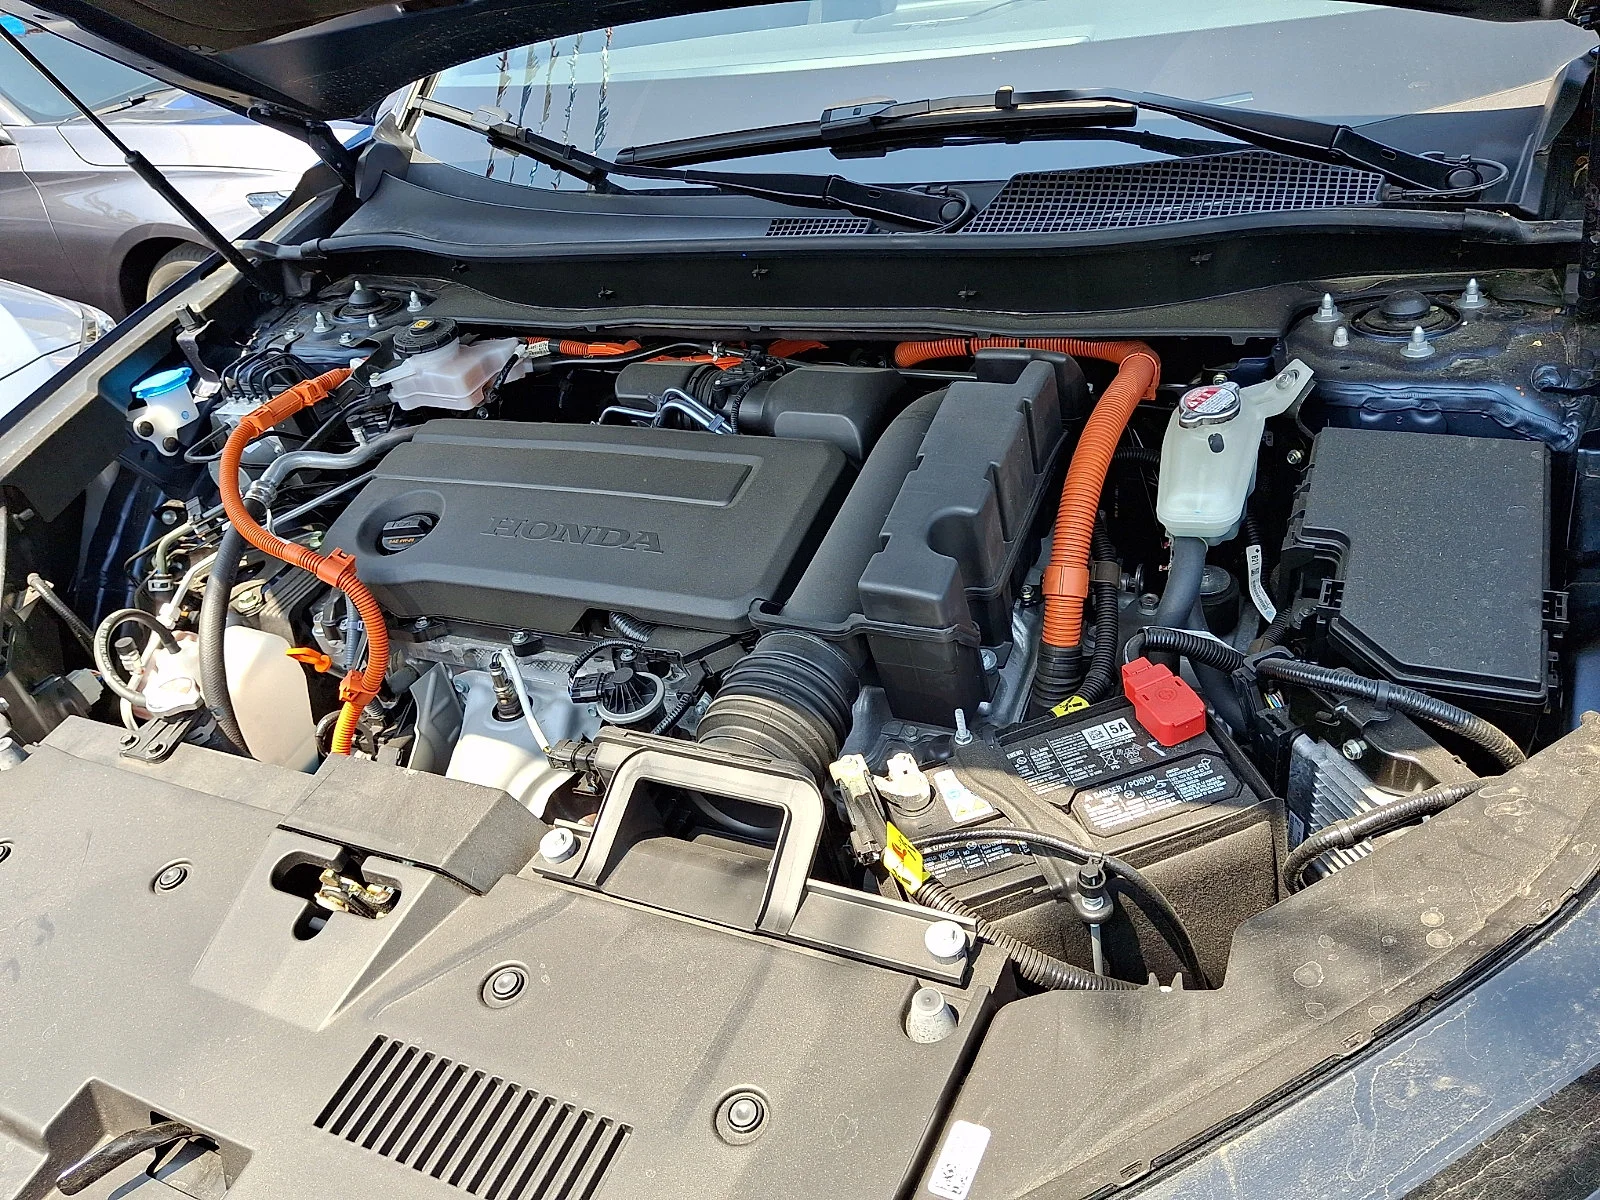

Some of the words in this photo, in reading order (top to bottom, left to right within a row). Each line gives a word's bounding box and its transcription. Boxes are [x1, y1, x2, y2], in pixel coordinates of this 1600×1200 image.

[480, 516, 664, 554] HONDA
[1109, 722, 1129, 734] 5A
[1092, 784, 1123, 798] DANGER
[1127, 774, 1156, 788] POISON
